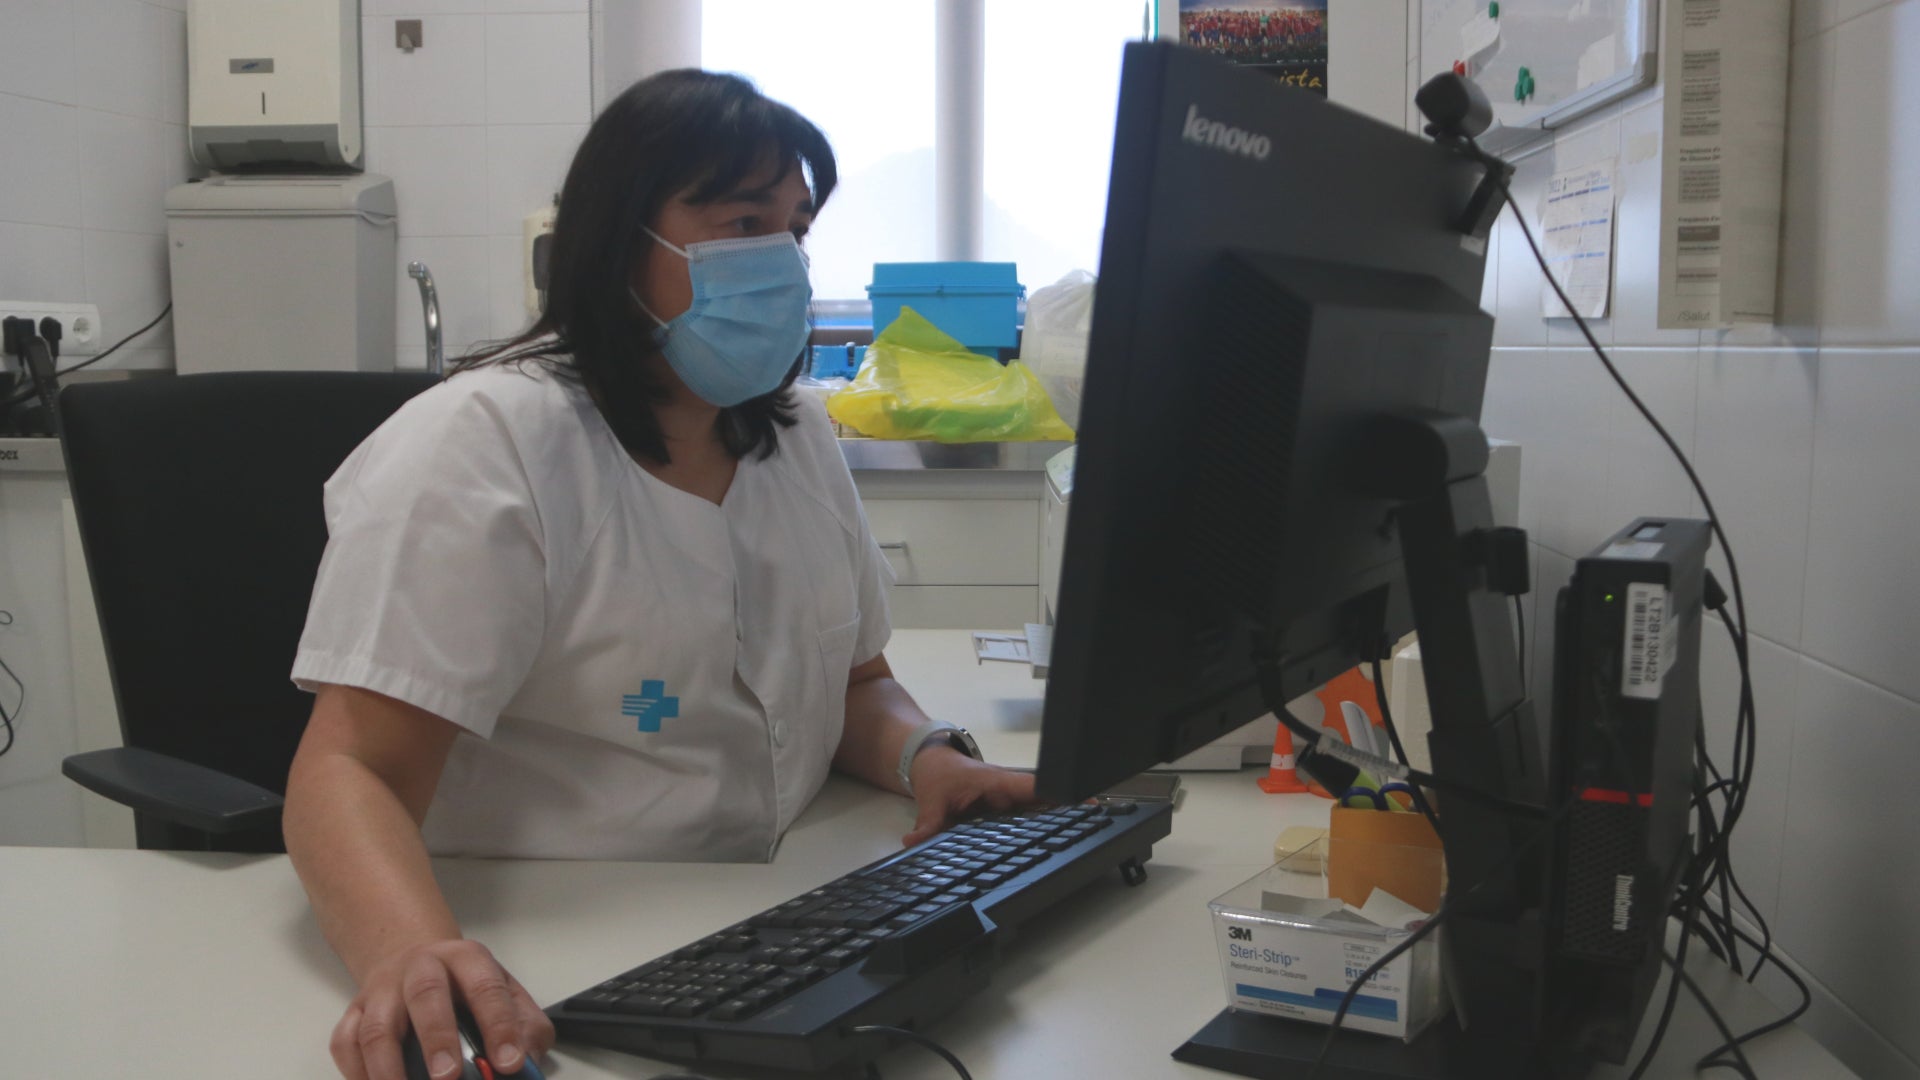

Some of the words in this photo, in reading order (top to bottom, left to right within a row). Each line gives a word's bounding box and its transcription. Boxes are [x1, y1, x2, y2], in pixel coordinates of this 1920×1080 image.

[1182, 102, 1271, 160] lenovo
[1644, 597, 1663, 682] LT2B130422
[1228, 926, 1252, 941] 3M
